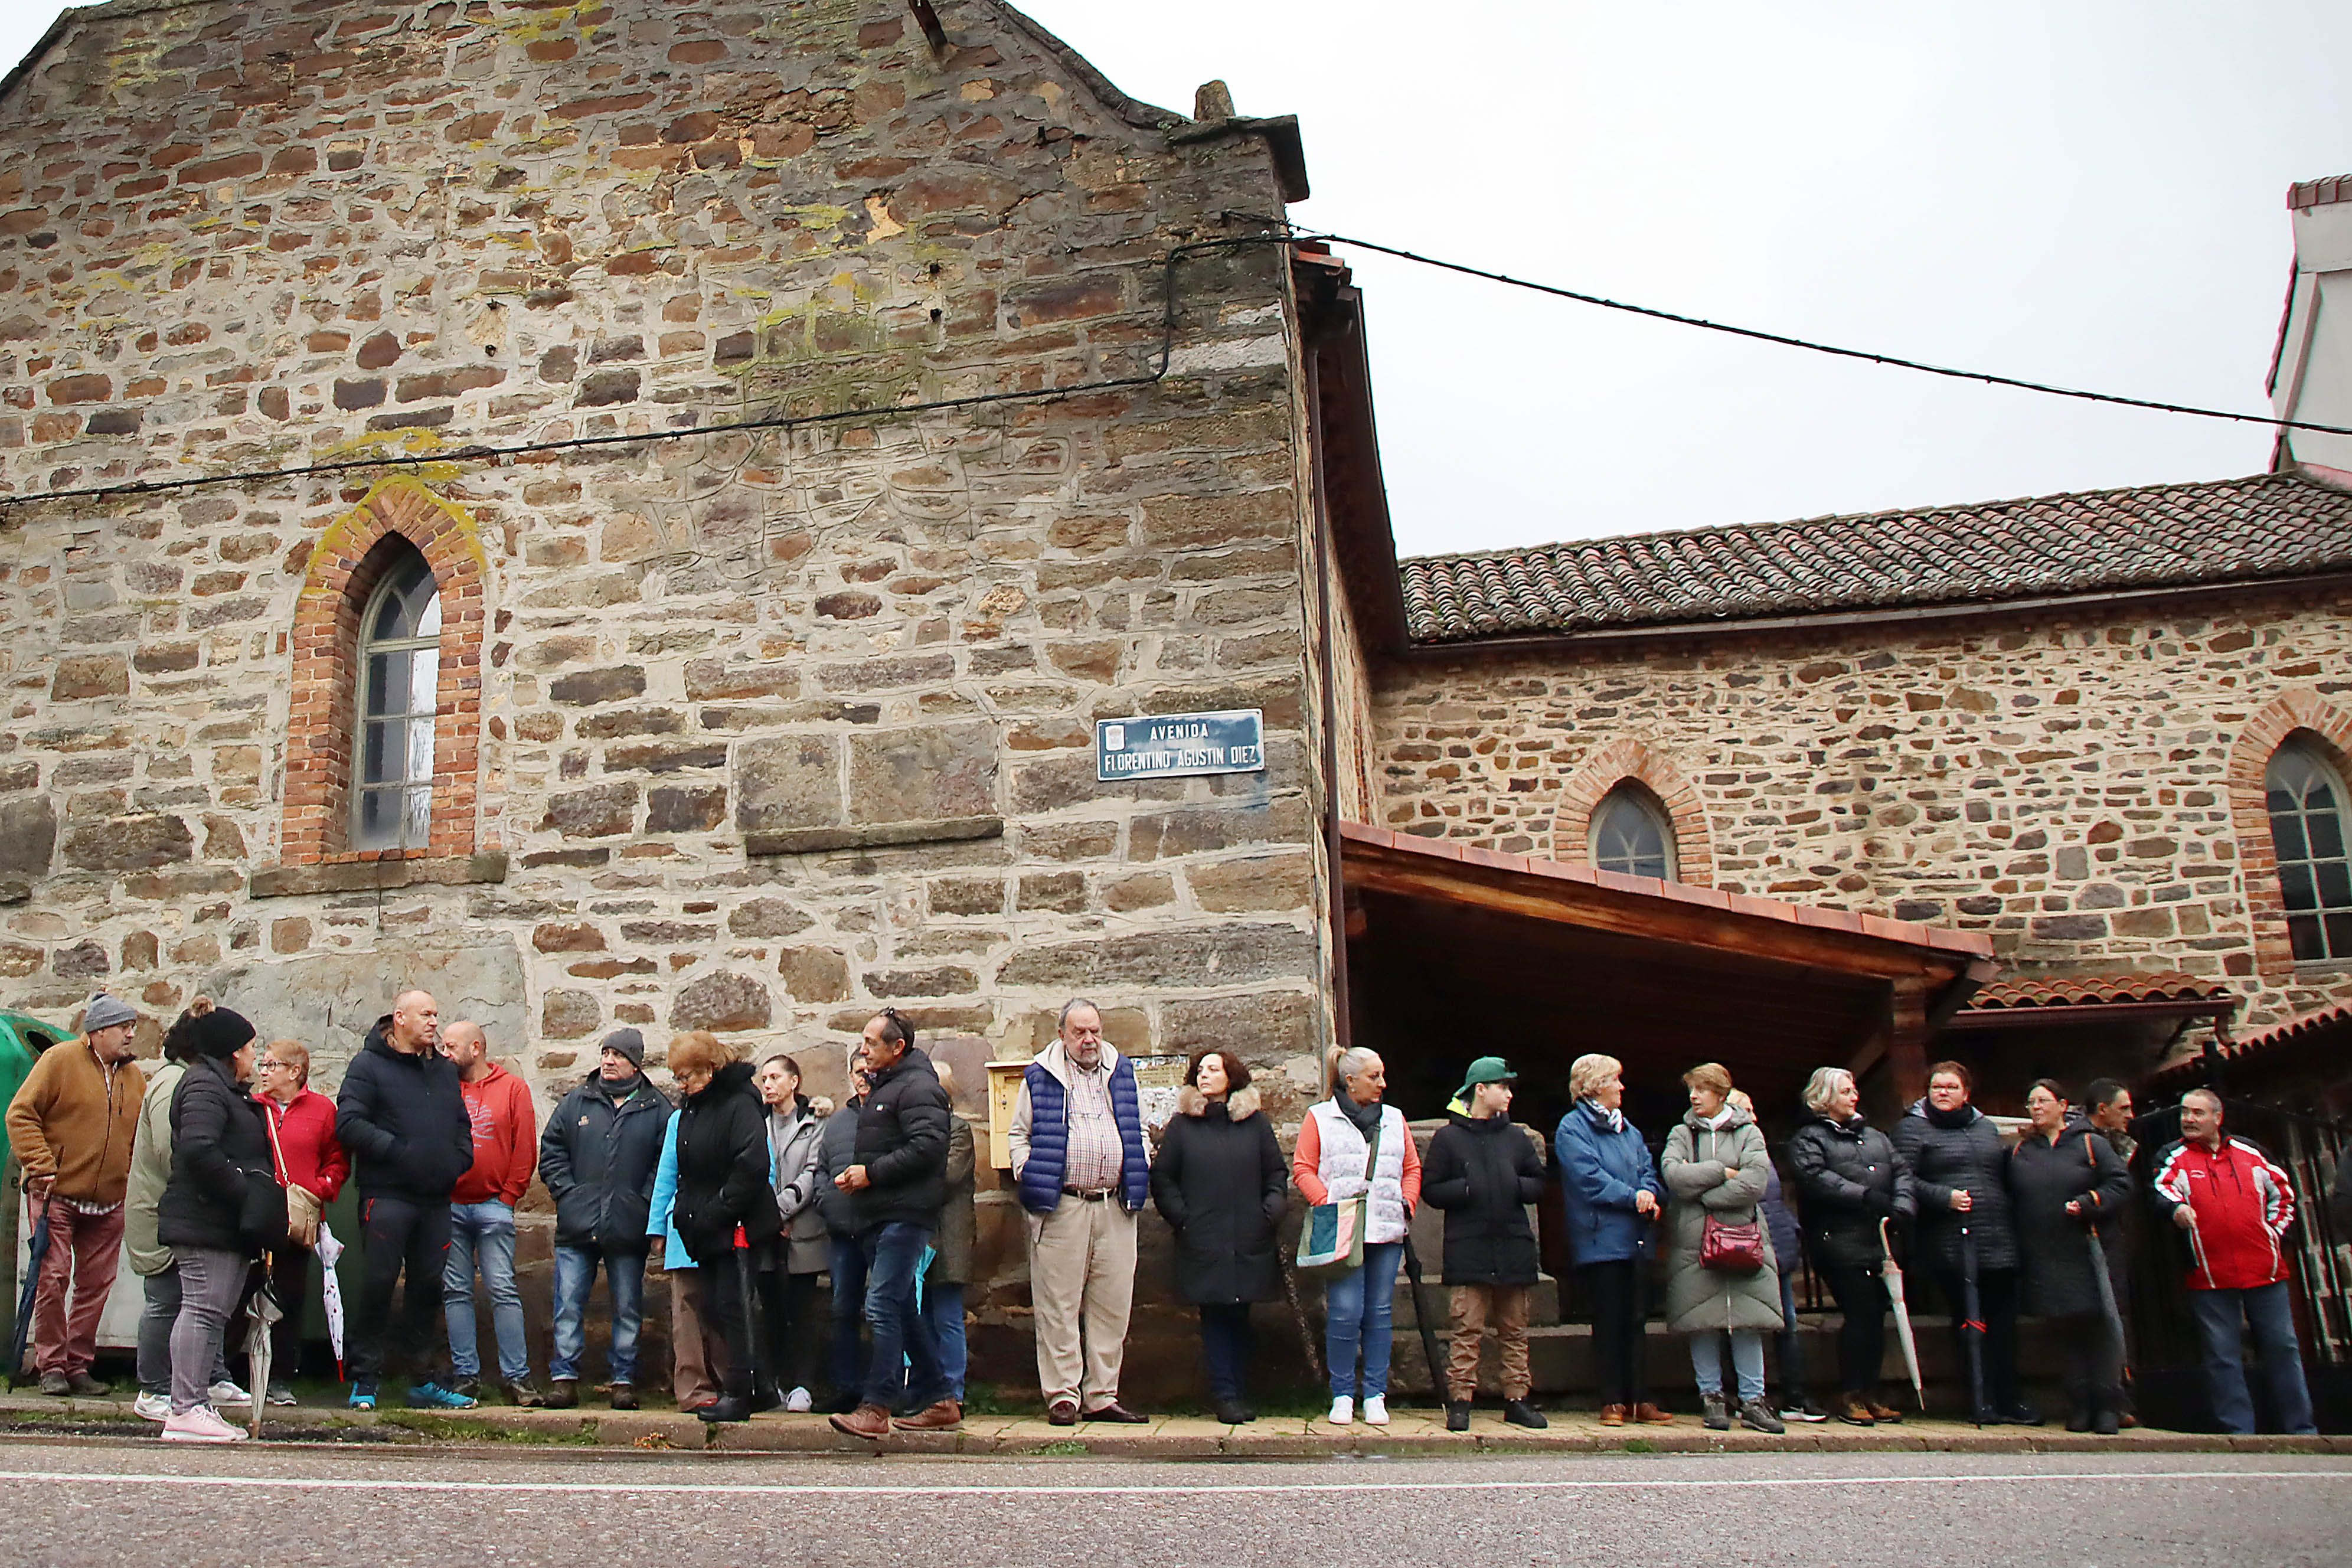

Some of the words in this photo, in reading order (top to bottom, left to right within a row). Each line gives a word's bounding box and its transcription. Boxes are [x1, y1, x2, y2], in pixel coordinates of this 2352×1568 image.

[1151, 723, 1208, 740] AVENIDA
[1105, 750, 1171, 772] FLORENTINO
[1178, 747, 1224, 767] AGUSTIN
[1231, 745, 1256, 765] DIEZ
